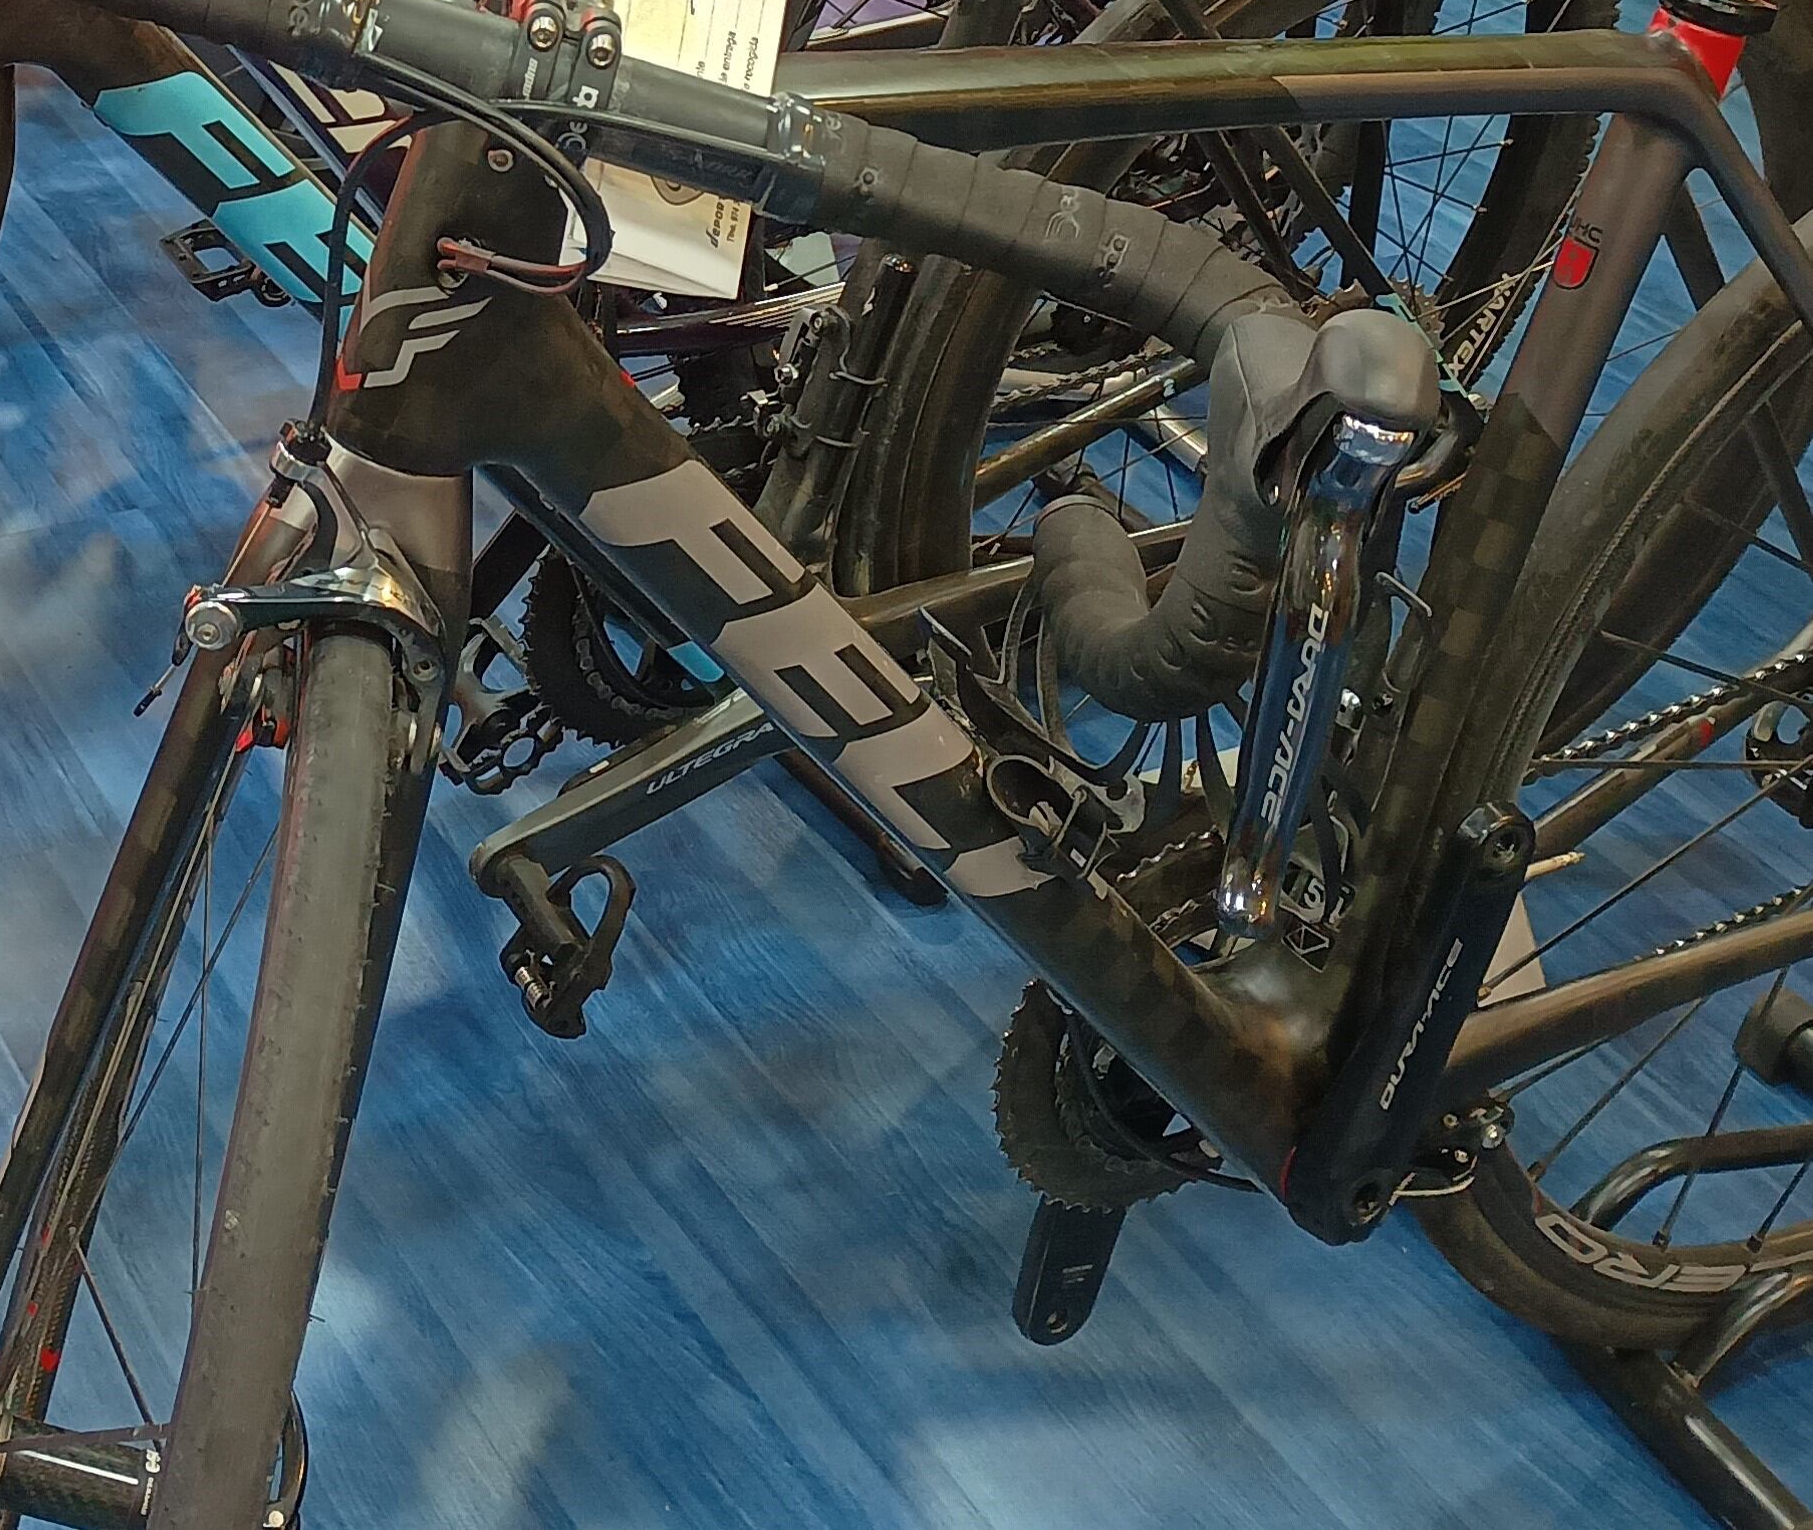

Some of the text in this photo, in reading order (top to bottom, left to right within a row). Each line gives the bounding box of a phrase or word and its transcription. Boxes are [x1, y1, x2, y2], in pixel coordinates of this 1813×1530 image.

[645, 721, 775, 795] ULTEGRA
[1261, 602, 1329, 824] DURA-ACE
[1378, 936, 1465, 1111] DURA-ACE
